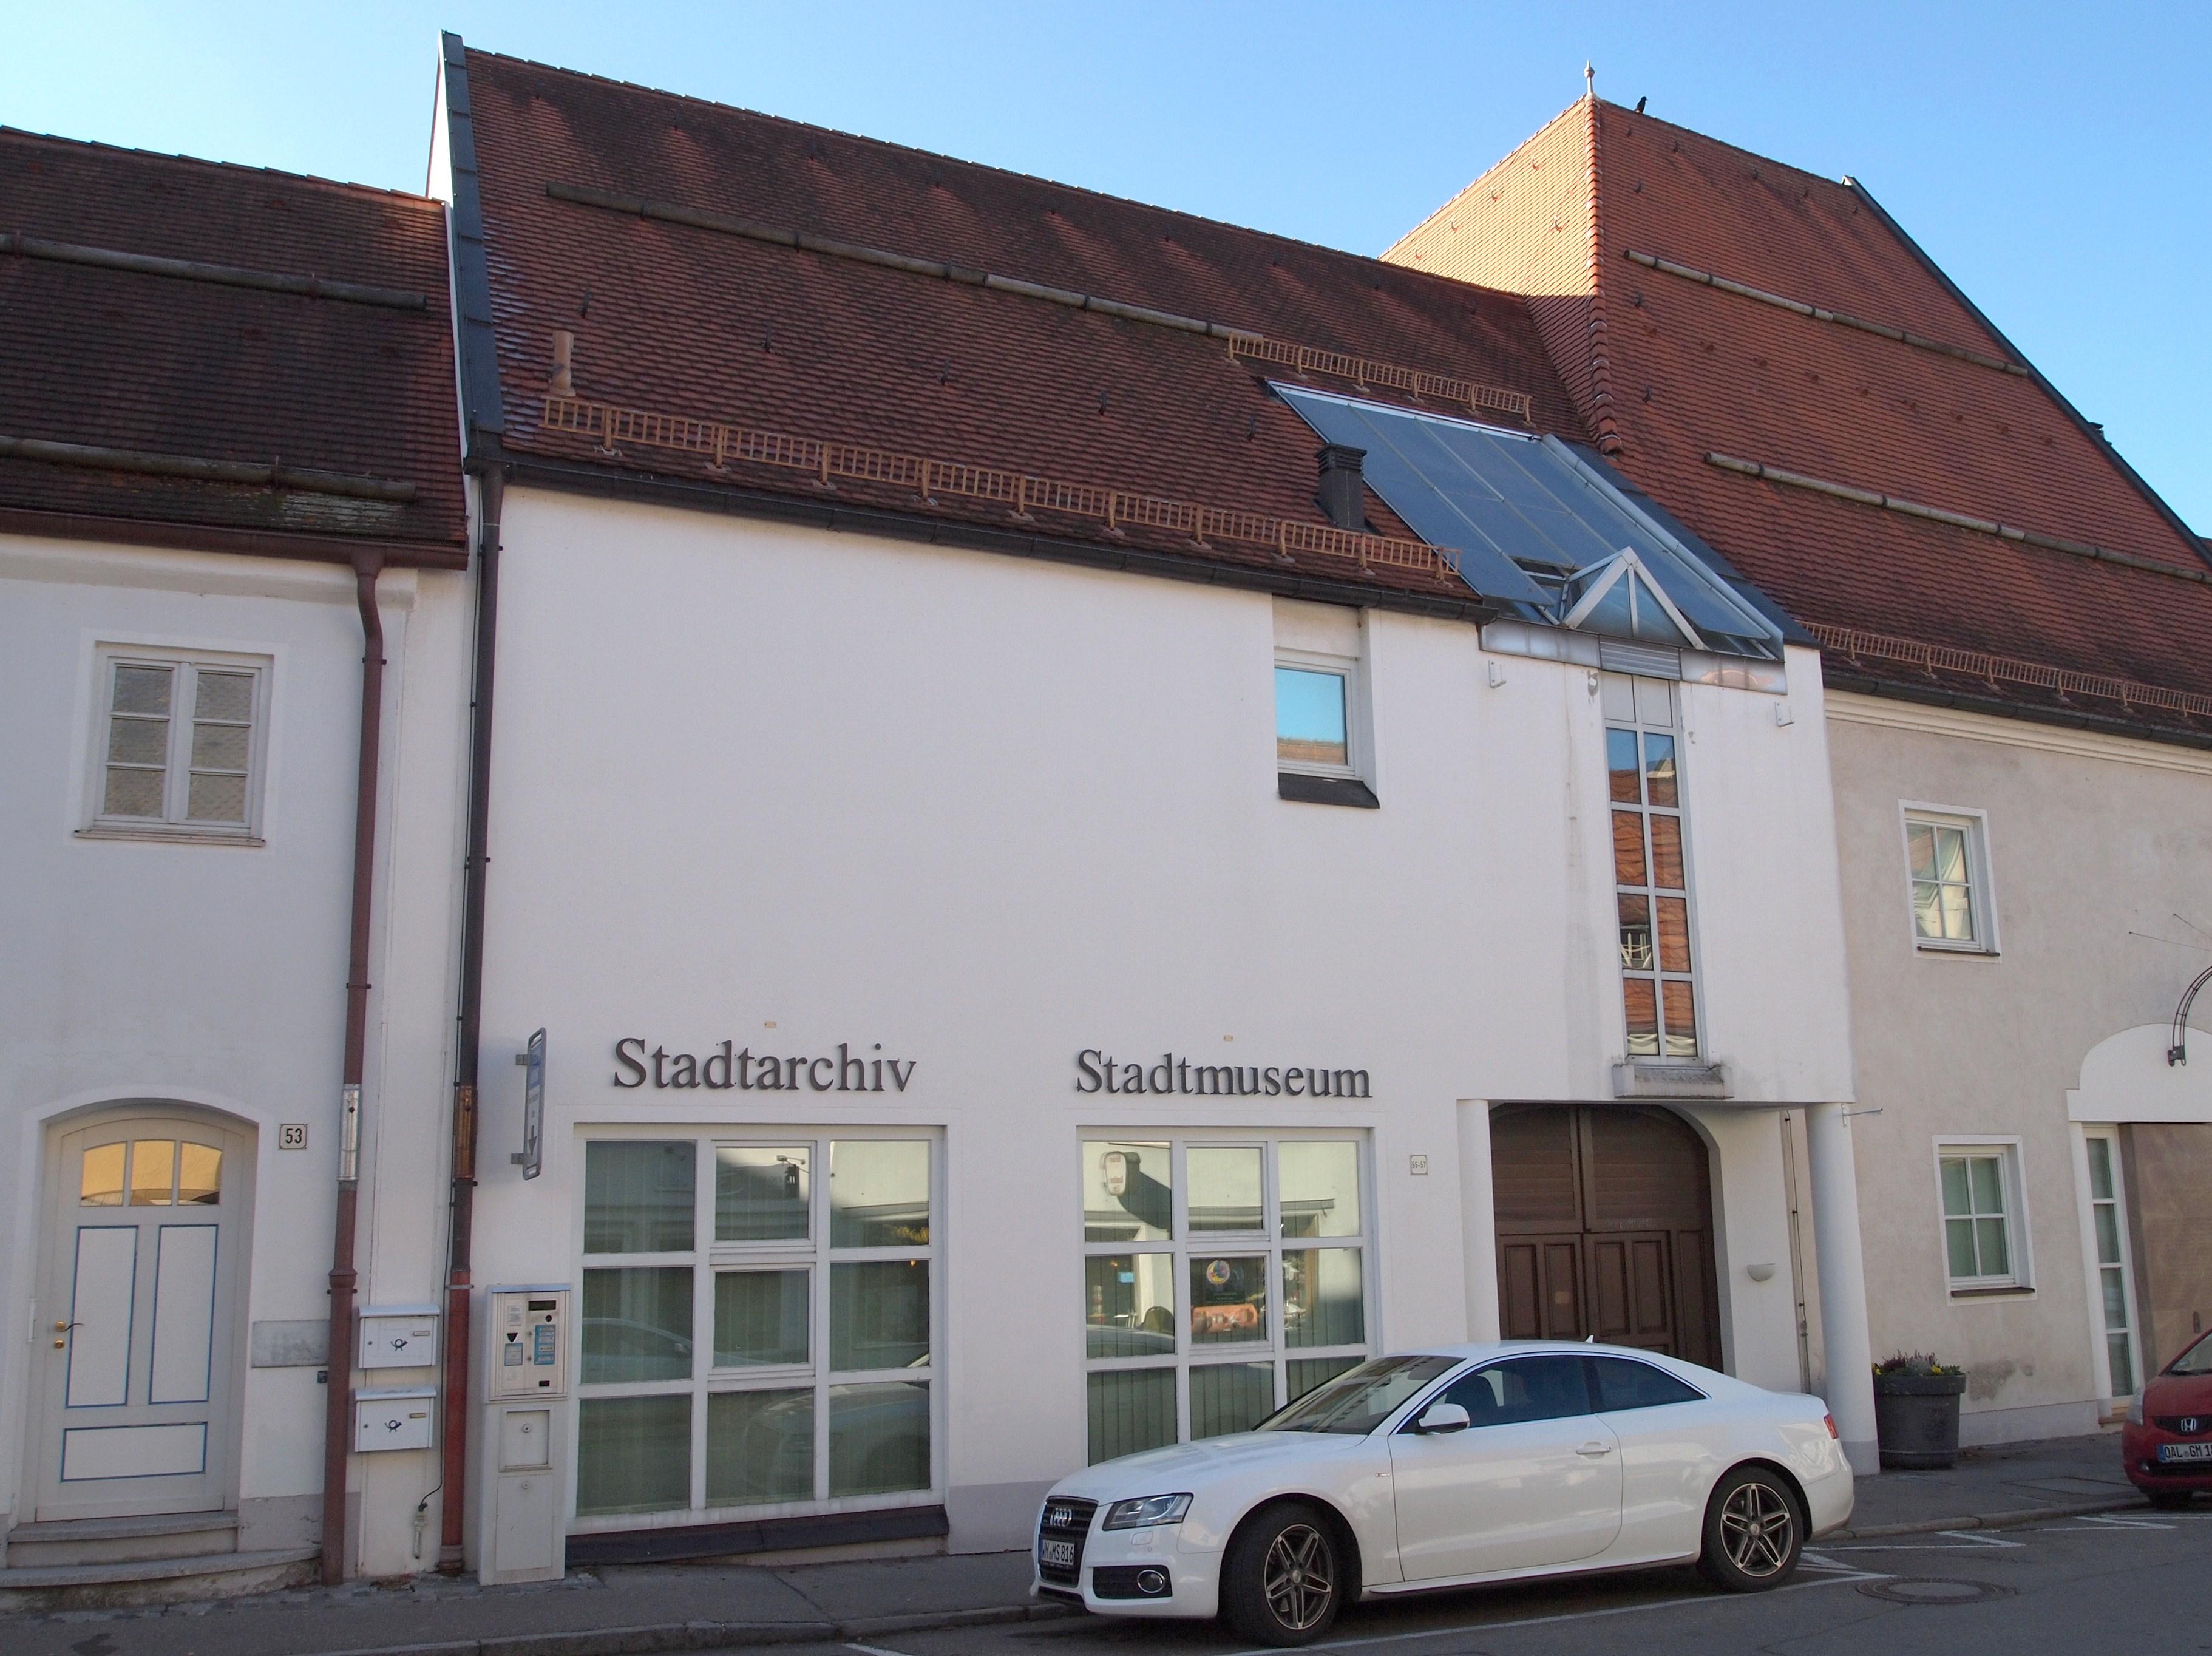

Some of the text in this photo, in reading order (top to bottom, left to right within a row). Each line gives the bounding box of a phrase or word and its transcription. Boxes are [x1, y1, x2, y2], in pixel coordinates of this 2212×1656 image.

[614, 1037, 917, 1093] Stadtarchiv
[1076, 1048, 1373, 1098] Stadtmuseum
[285, 1128, 302, 1144] 53
